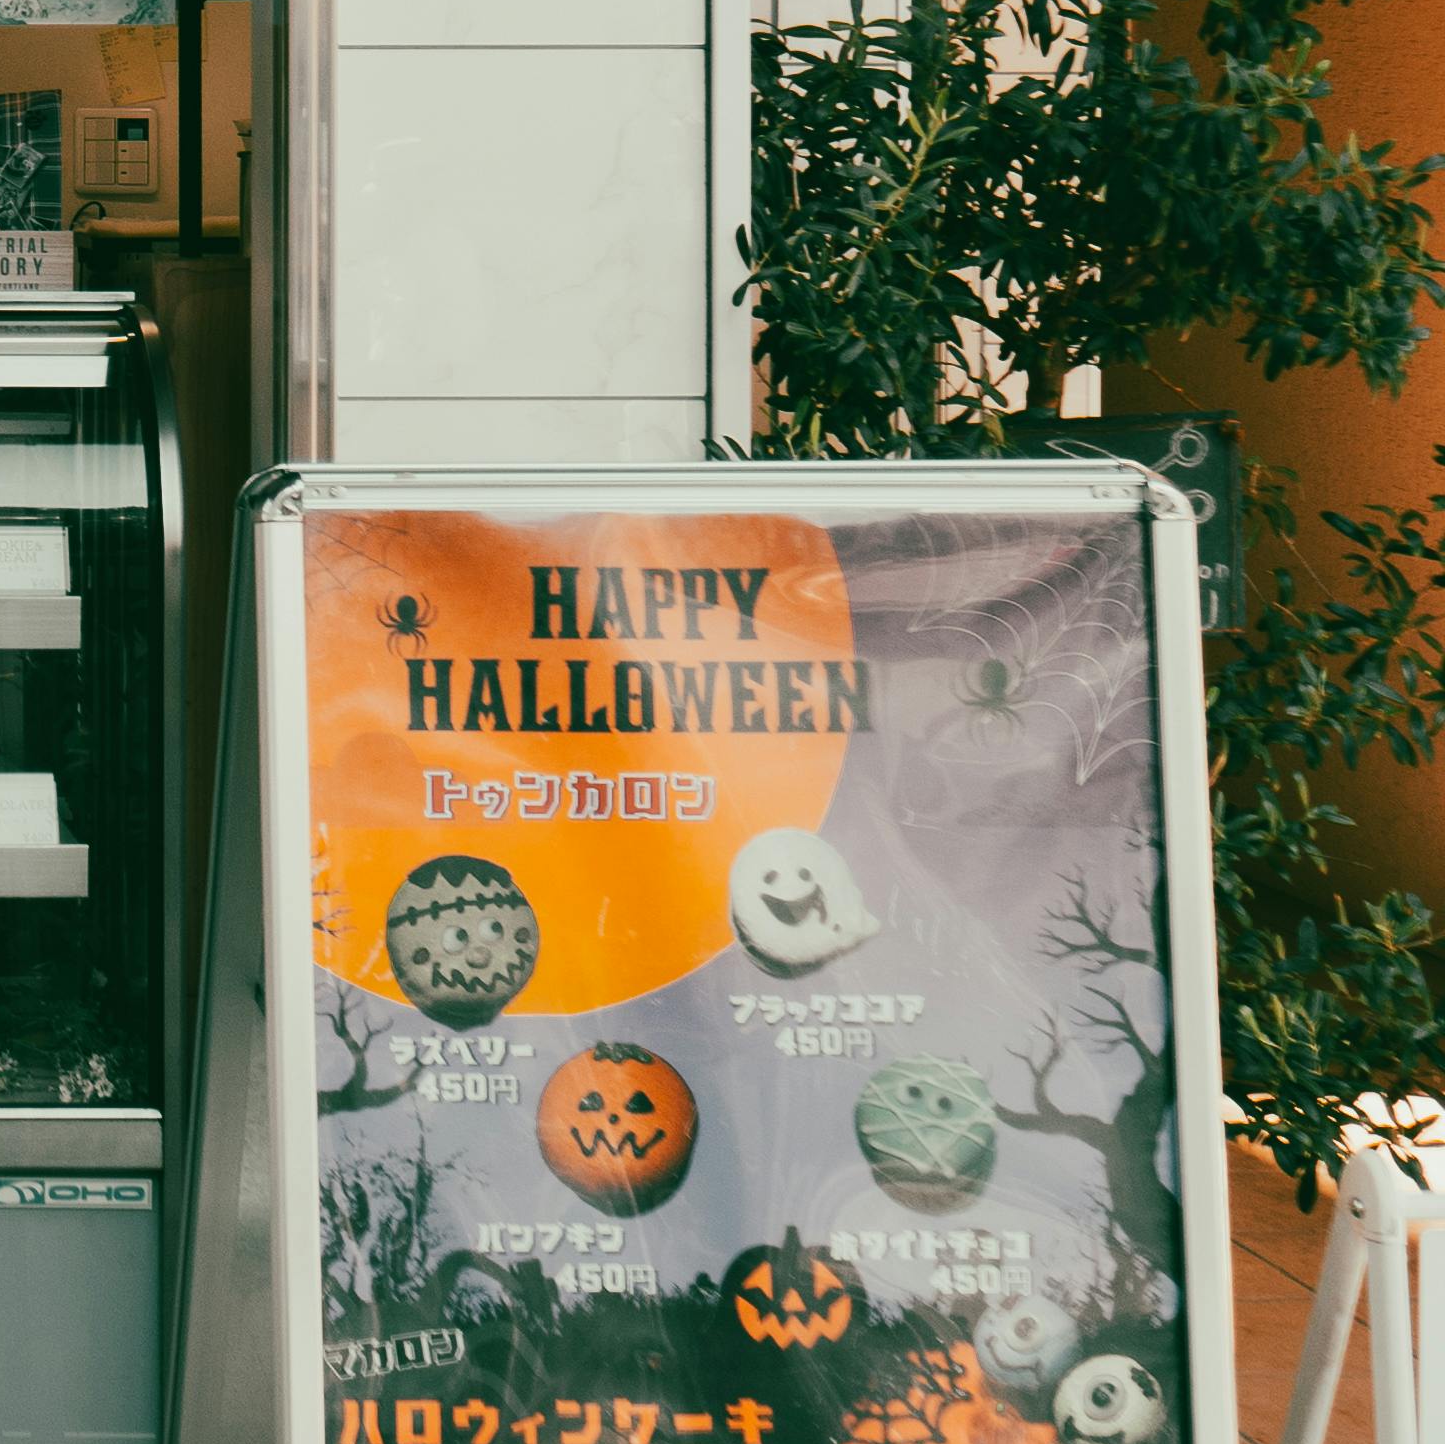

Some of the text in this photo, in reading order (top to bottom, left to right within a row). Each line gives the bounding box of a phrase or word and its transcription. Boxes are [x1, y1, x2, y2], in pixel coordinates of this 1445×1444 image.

[529, 565, 770, 641] HAPPY
[406, 658, 875, 734] HALLOWEEN
[423, 769, 717, 822] トゥンカロン
[728, 993, 926, 1025] ブラックココア
[774, 1025, 875, 1059] 450円
[417, 1073, 520, 1105] 450円
[829, 1230, 1031, 1261] ホワイトチョコ
[554, 1262, 659, 1296] 450円
[931, 1264, 1032, 1297] 450円
[323, 1327, 466, 1380] マカロン
